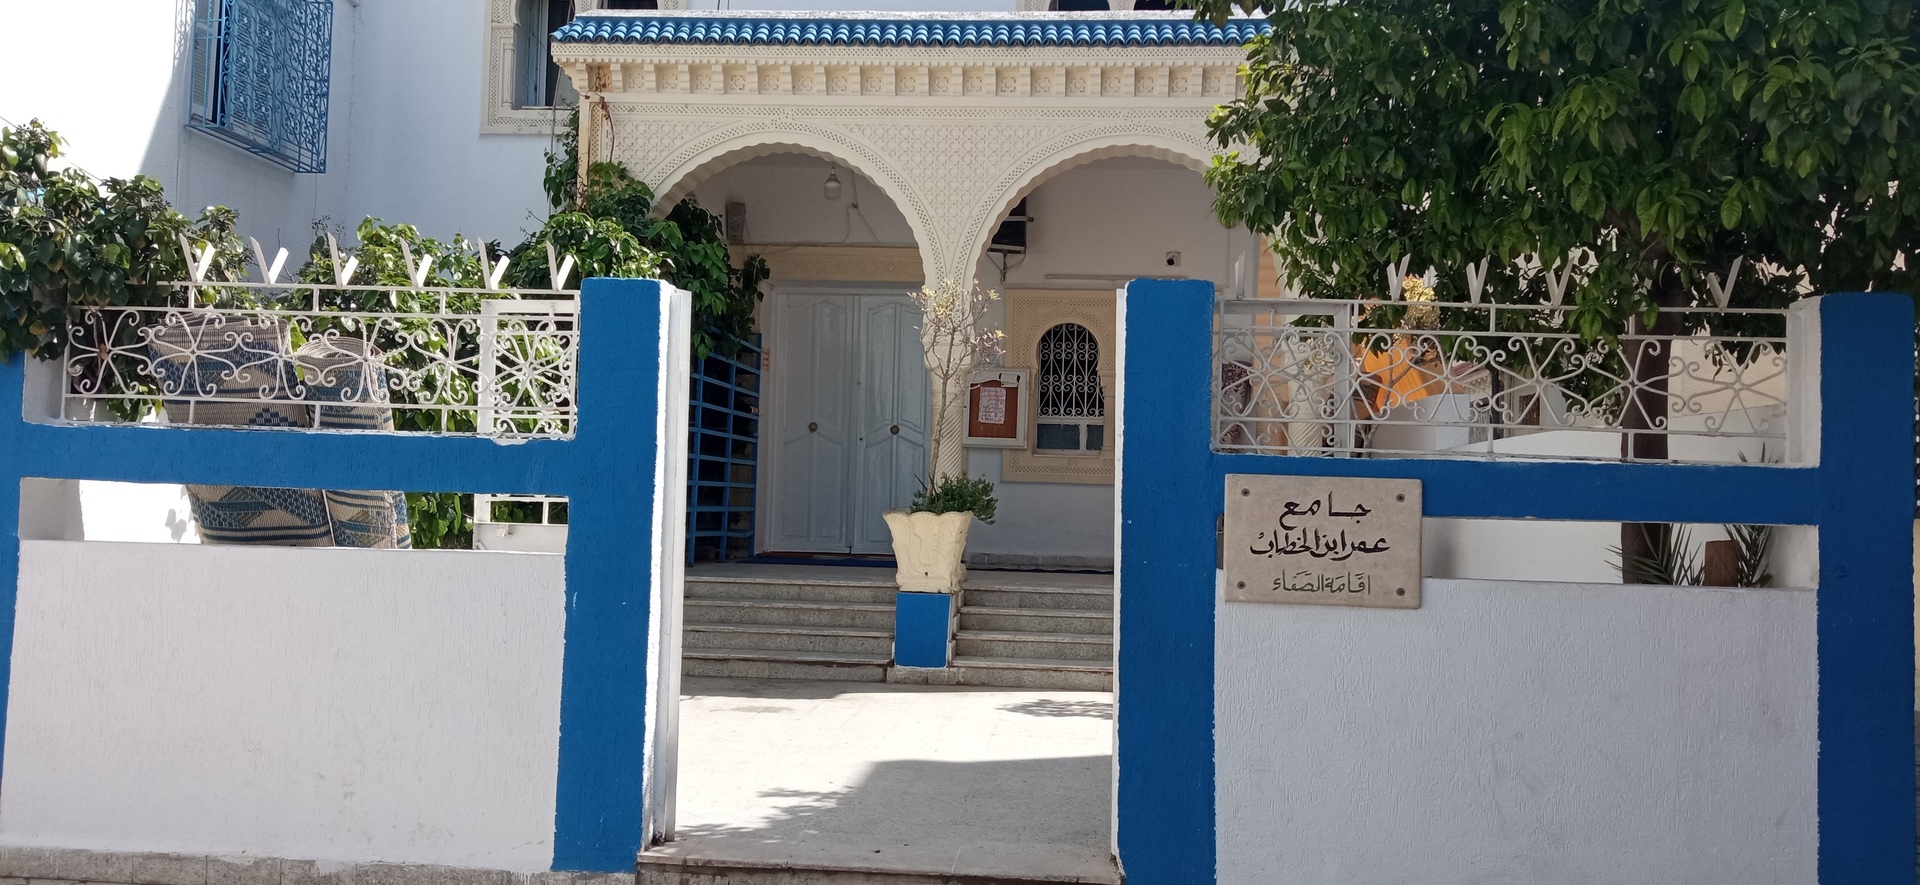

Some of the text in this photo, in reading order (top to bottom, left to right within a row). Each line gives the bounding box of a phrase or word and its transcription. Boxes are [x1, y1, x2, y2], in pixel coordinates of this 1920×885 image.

[1279, 490, 1372, 531] جامع
[1309, 529, 1347, 558] ابن
[1329, 537, 1391, 561] عمر
